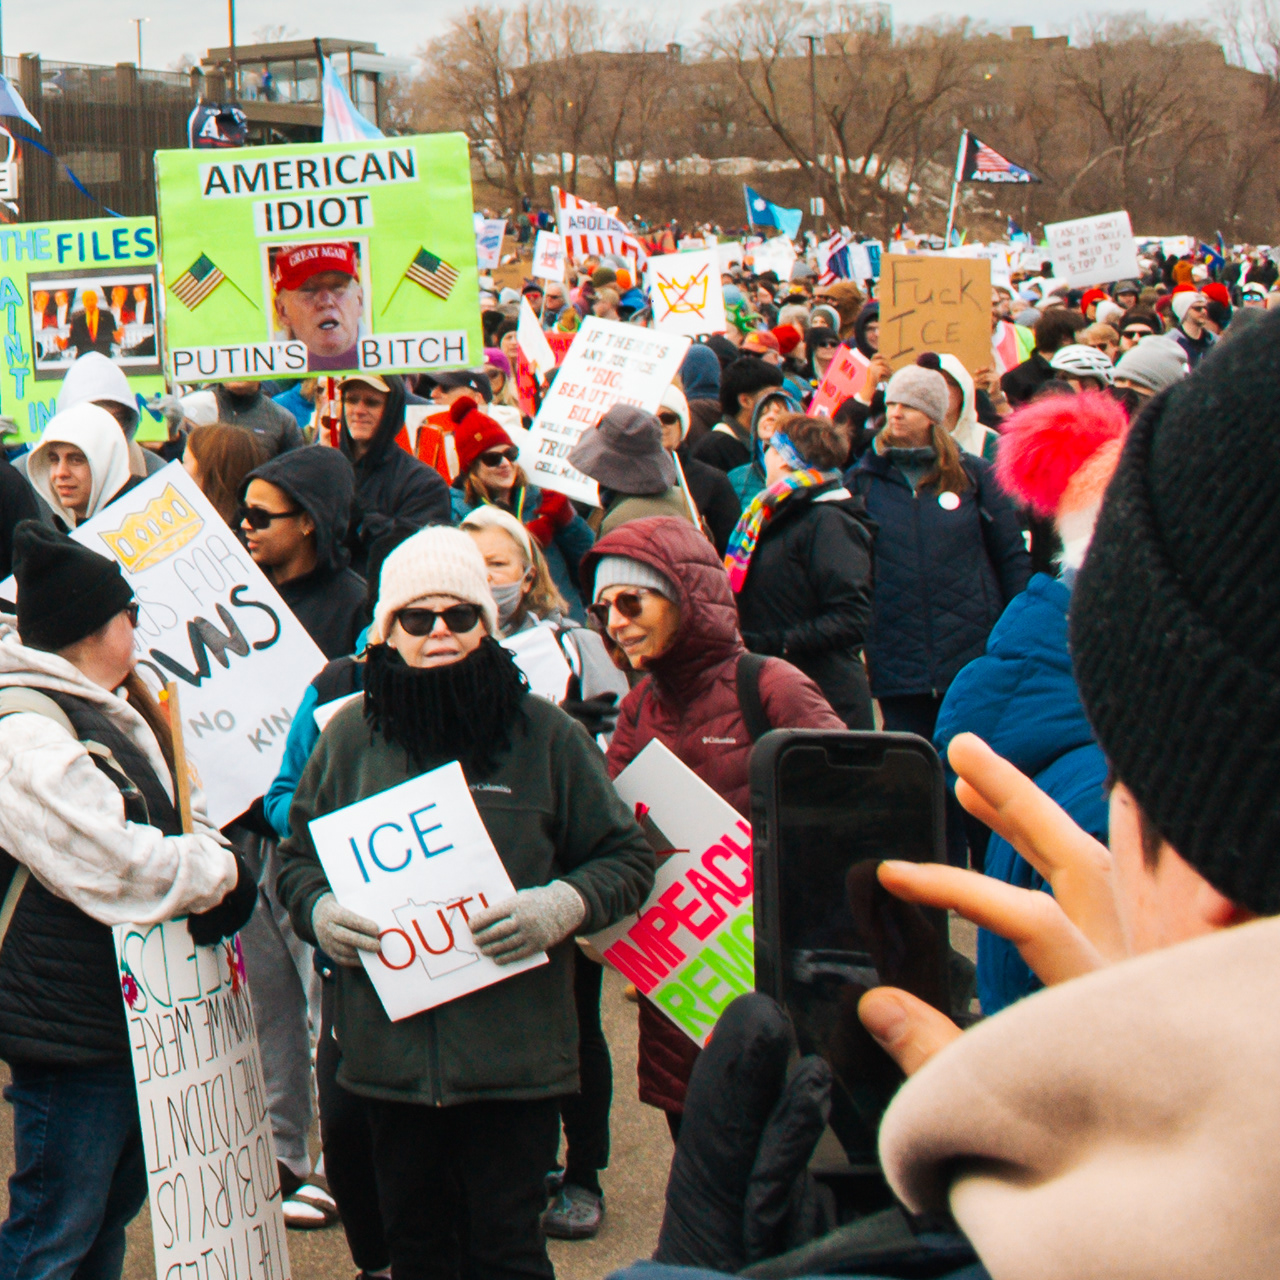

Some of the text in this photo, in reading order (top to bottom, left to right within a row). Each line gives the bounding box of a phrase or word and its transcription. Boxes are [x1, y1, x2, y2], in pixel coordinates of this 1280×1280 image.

[203, 148, 416, 197] AMERICAN
[264, 195, 370, 232] IDIOT
[568, 215, 622, 232] ABOLIS
[56, 227, 156, 264] FILES
[288, 247, 319, 267] GREAT
[320, 245, 347, 261] AGAIN
[1068, 258, 1096, 272] STOP
[1108, 242, 1121, 252] TO
[890, 258, 983, 313] Fuck
[580, 348, 604, 363] ANY
[586, 330, 603, 344] IF
[886, 309, 961, 360] ICE
[172, 336, 466, 378] PUTIN'S BITCH
[538, 437, 573, 458] TRU
[173, 534, 249, 607] FOR
[188, 706, 293, 754] NO KIN
[708, 736, 737, 745] Columbia
[476, 783, 512, 794] Columbia
[348, 802, 455, 884] ICE
[654, 904, 755, 1039] REMO
[130, 1004, 200, 1085] WERE
[149, 1072, 230, 1175] DIDN'T
[156, 1172, 191, 1249] US
[198, 1145, 257, 1240] BURY
